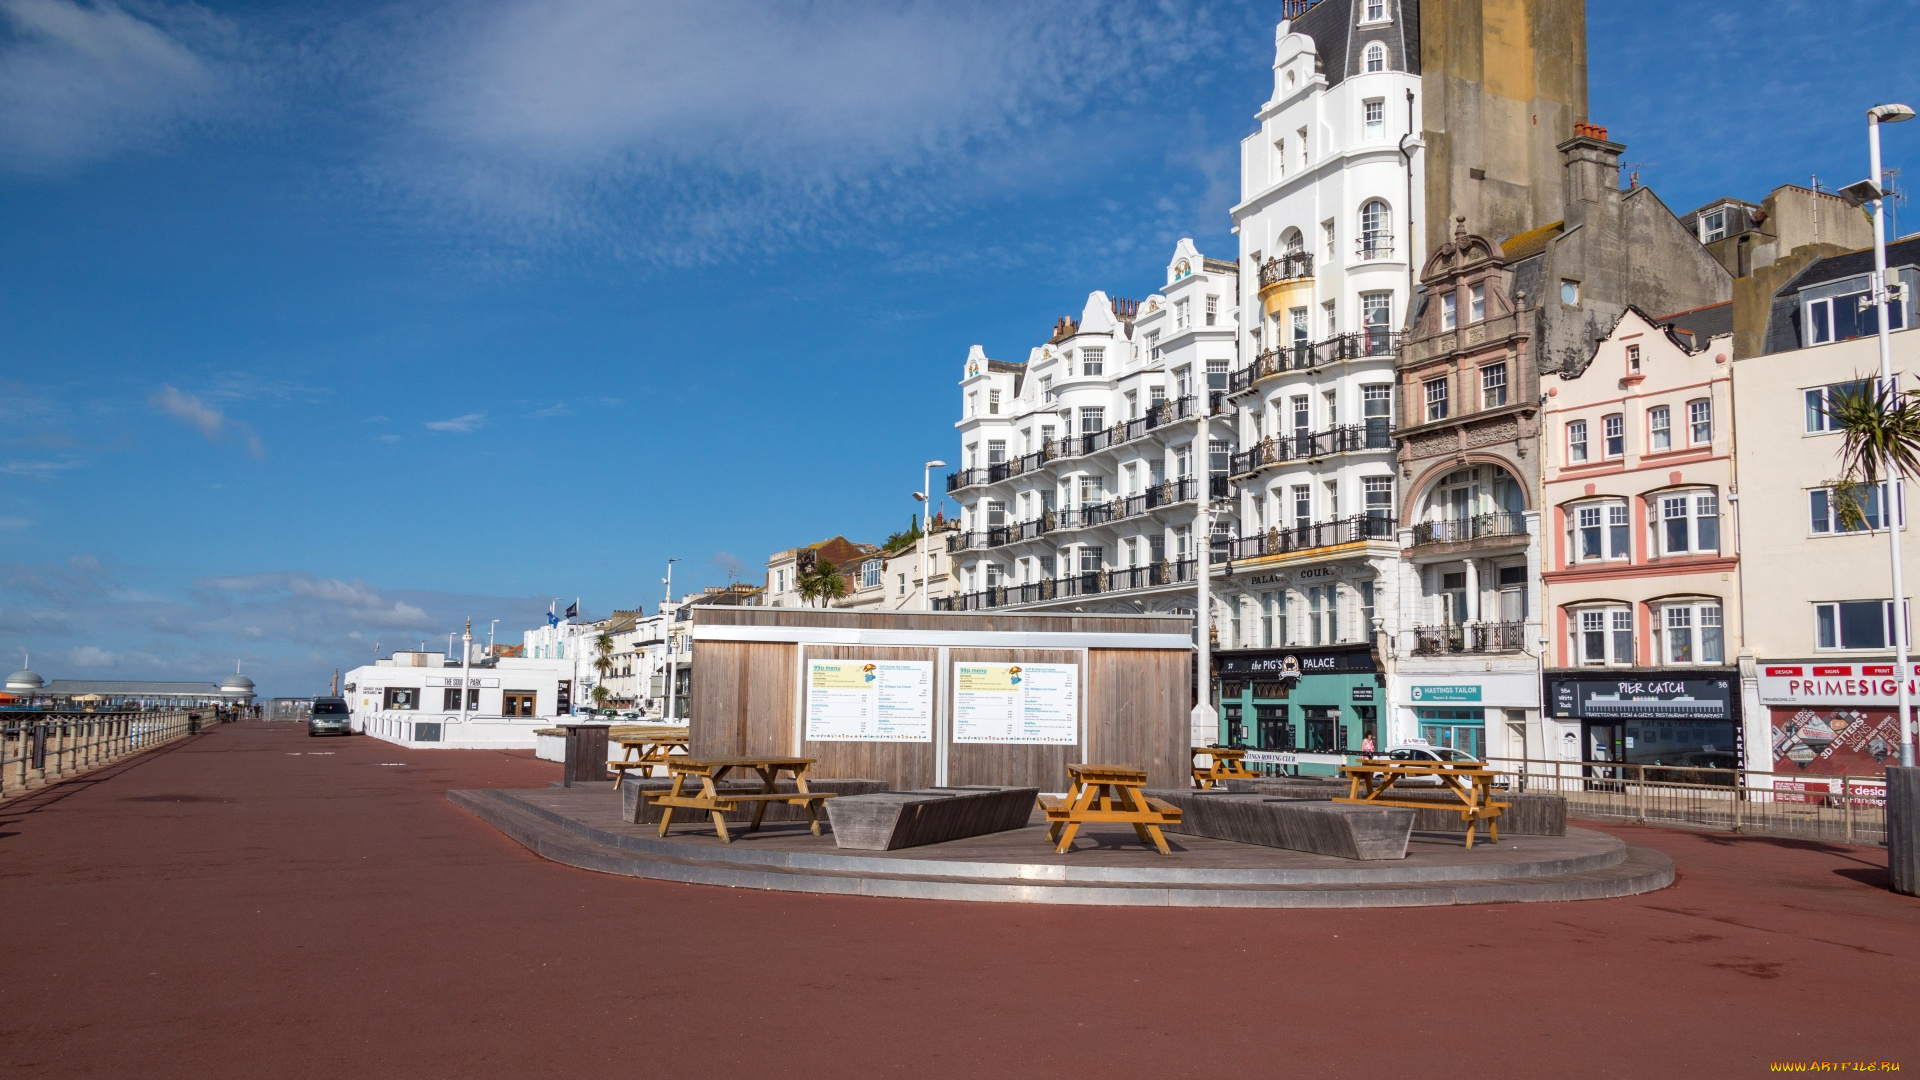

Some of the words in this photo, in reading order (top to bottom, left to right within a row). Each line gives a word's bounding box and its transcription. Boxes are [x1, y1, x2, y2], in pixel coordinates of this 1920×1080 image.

[1251, 575, 1284, 584] PALAC
[1300, 568, 1334, 578] COUR
[1252, 661, 1262, 670] the
[1264, 659, 1282, 670] PIG'S
[1304, 658, 1334, 668] PALACE
[1618, 682, 1645, 694] PIER
[1648, 682, 1684, 694] CATCH
[1790, 679, 1920, 696] PRIMESIGN
[1792, 708, 1808, 722] LEDS
[1796, 710, 1815, 727] SIGNS
[1820, 746, 1833, 760] 3D
[1831, 717, 1864, 750] LETTERS
[1846, 723, 1871, 748] SIGNS
[1853, 739, 1866, 752] SHOP
[1866, 729, 1878, 740] SIGN
[1876, 715, 1892, 730] WORK
[1855, 786, 1887, 796] desig
